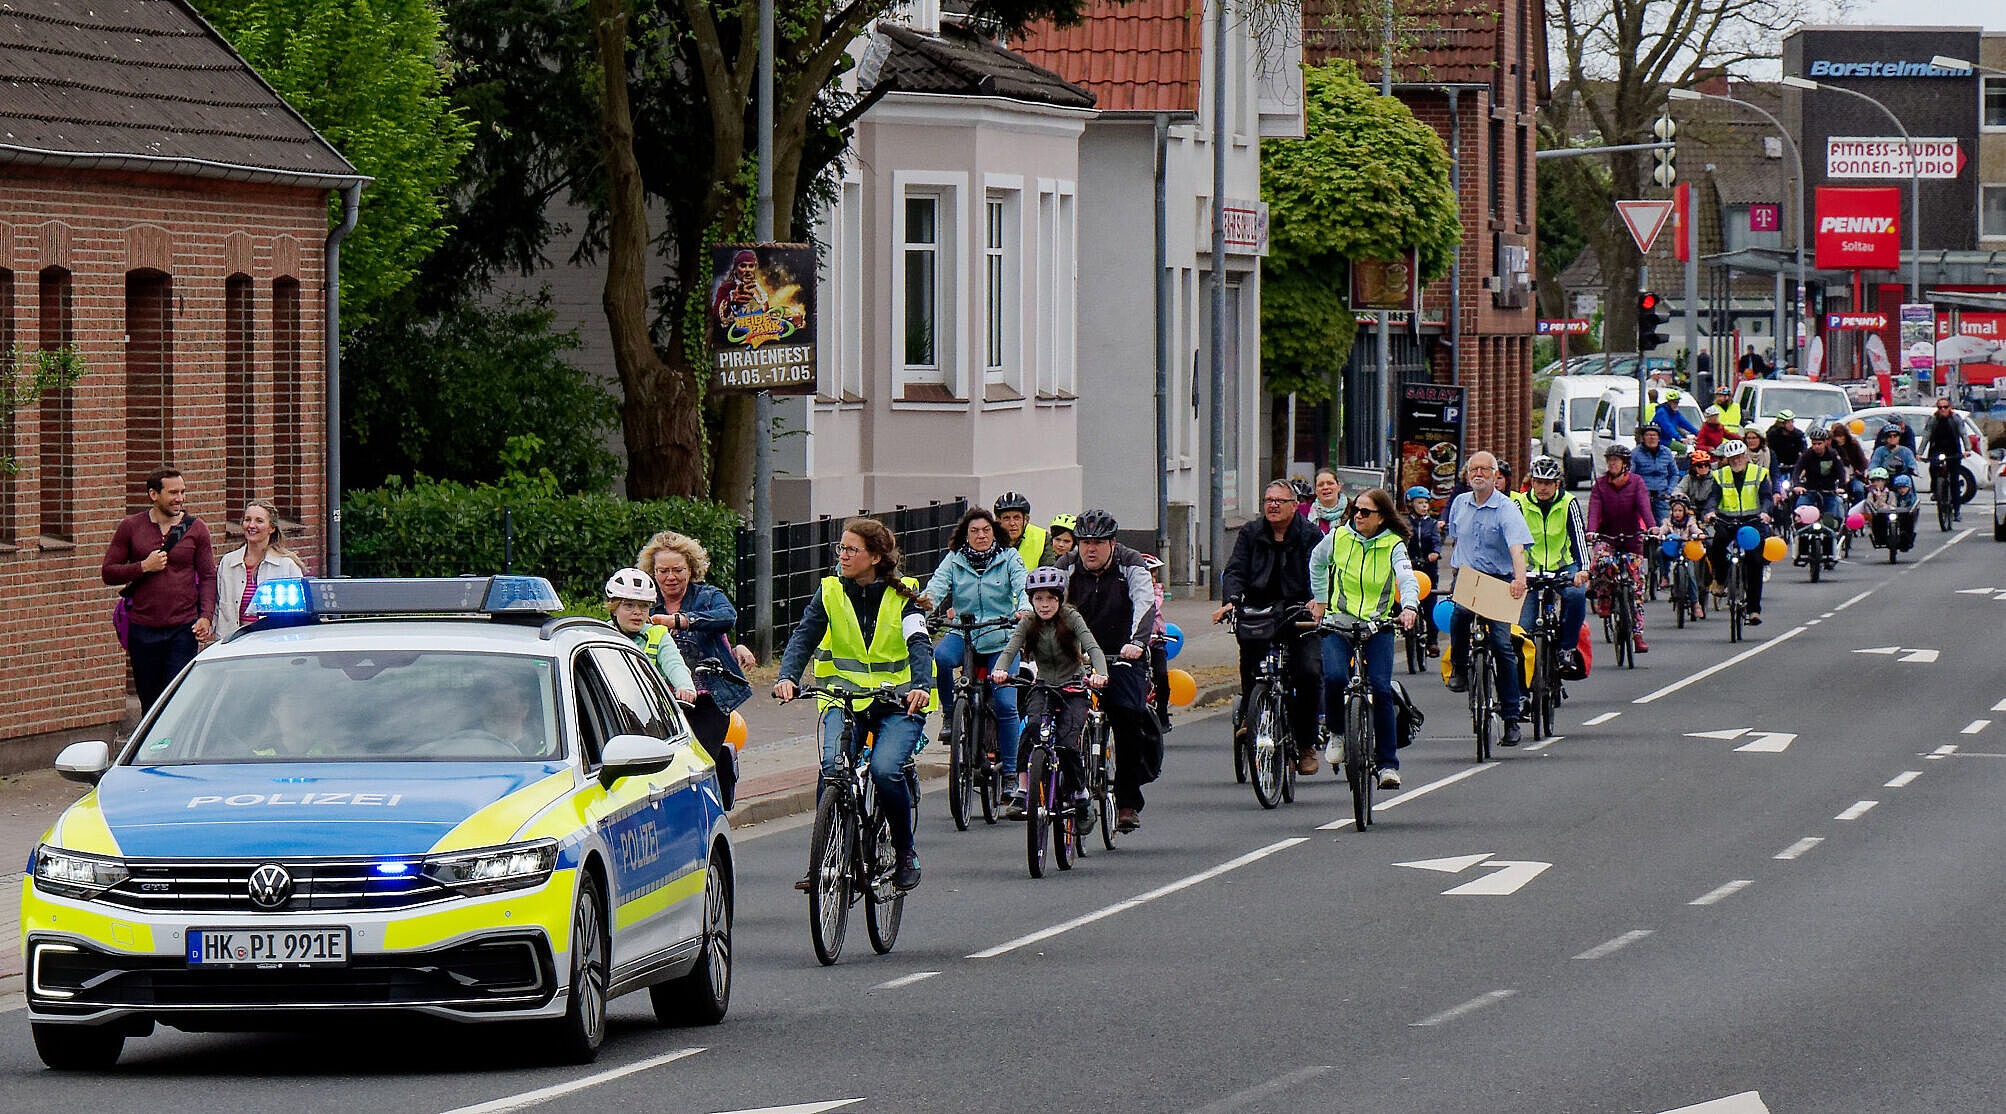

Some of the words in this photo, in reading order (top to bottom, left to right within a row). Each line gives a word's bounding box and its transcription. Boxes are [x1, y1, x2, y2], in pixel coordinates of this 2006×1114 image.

[1841, 241, 1875, 252] Soltau
[1830, 316, 1841, 327] P
[1939, 320, 1998, 335] Etmal
[718, 346, 811, 369] PIRATENFEST
[719, 365, 816, 386] 14.05.-17.05.
[186, 792, 403, 809] POLIZEI
[620, 820, 660, 874] POLIZEI
[191, 950, 199, 958] D
[204, 934, 234, 960] HK
[250, 933, 277, 960] PI
[284, 932, 342, 960] 991E
